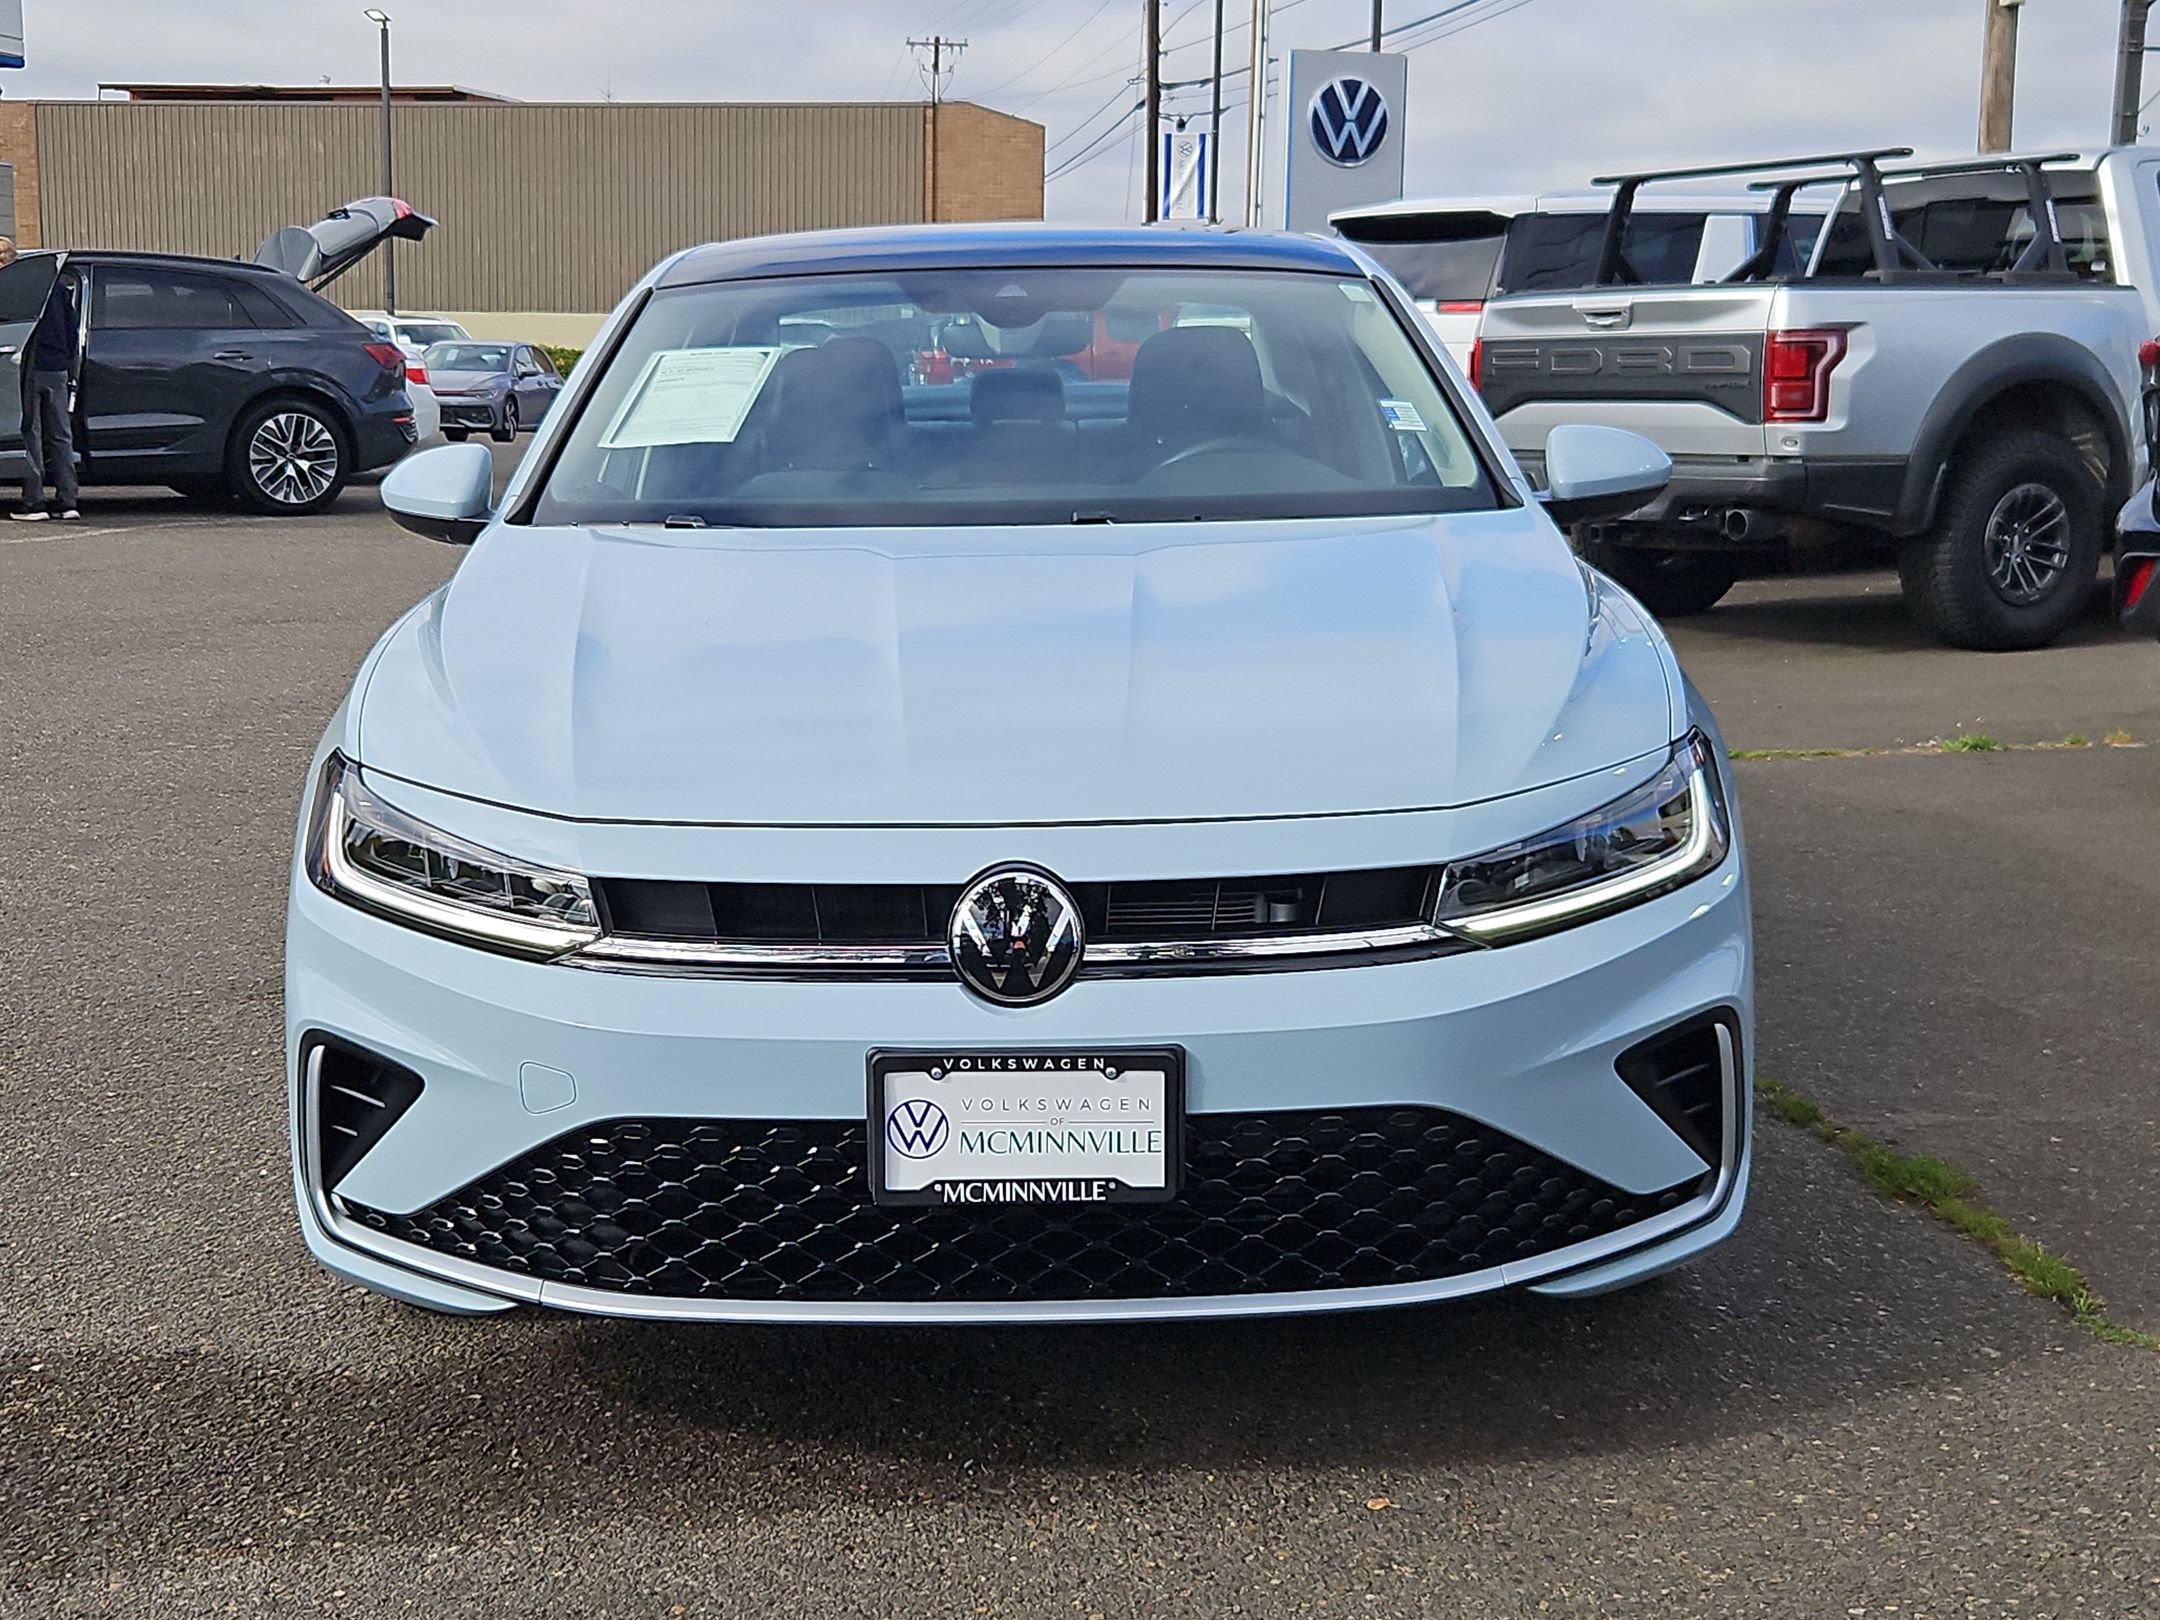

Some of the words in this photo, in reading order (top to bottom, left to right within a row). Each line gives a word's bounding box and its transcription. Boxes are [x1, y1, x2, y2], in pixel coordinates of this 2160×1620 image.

[1487, 345, 1750, 376] FORD
[943, 1057, 1105, 1070] VOLKSWAGEN
[961, 1098, 1151, 1111] VOLKSWAGEN
[1050, 1117, 1065, 1126] OF
[960, 1130, 1162, 1154] MCMINNVILLE
[943, 1181, 1106, 1203] MCMINNVILLE
